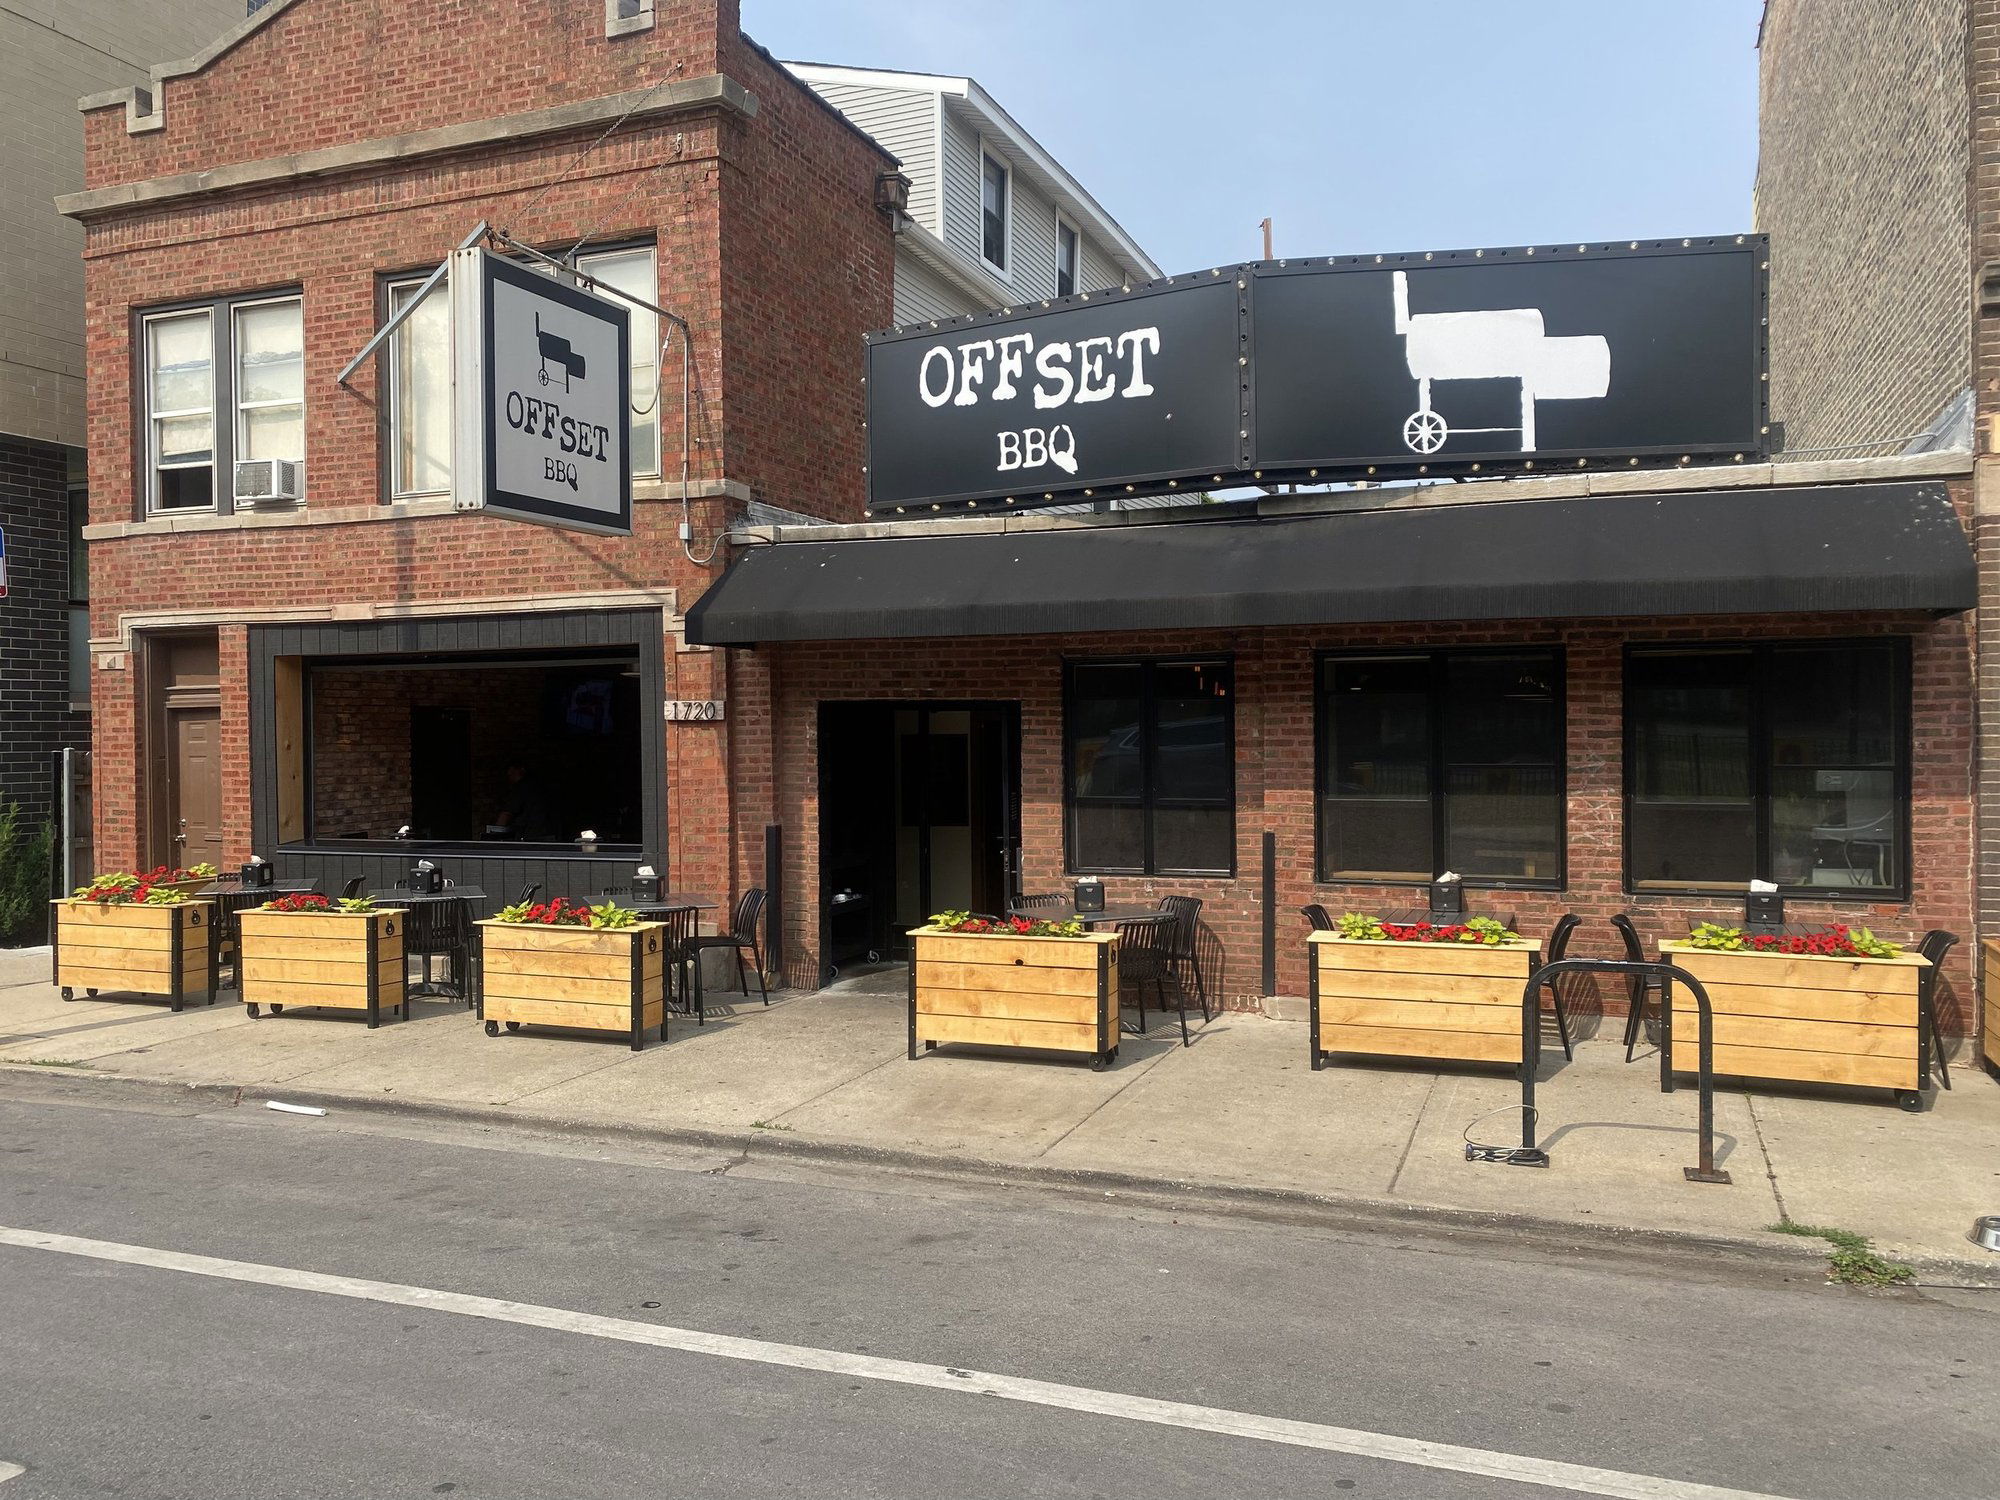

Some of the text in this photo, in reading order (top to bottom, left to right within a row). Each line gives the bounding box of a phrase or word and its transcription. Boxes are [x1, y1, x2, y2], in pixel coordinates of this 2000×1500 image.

[919, 327, 1160, 409] OFFSET
[506, 391, 609, 462] OFFSET
[997, 424, 1078, 474] BBQ
[544, 457, 578, 491] BBQ
[672, 702, 715, 719] 1720
